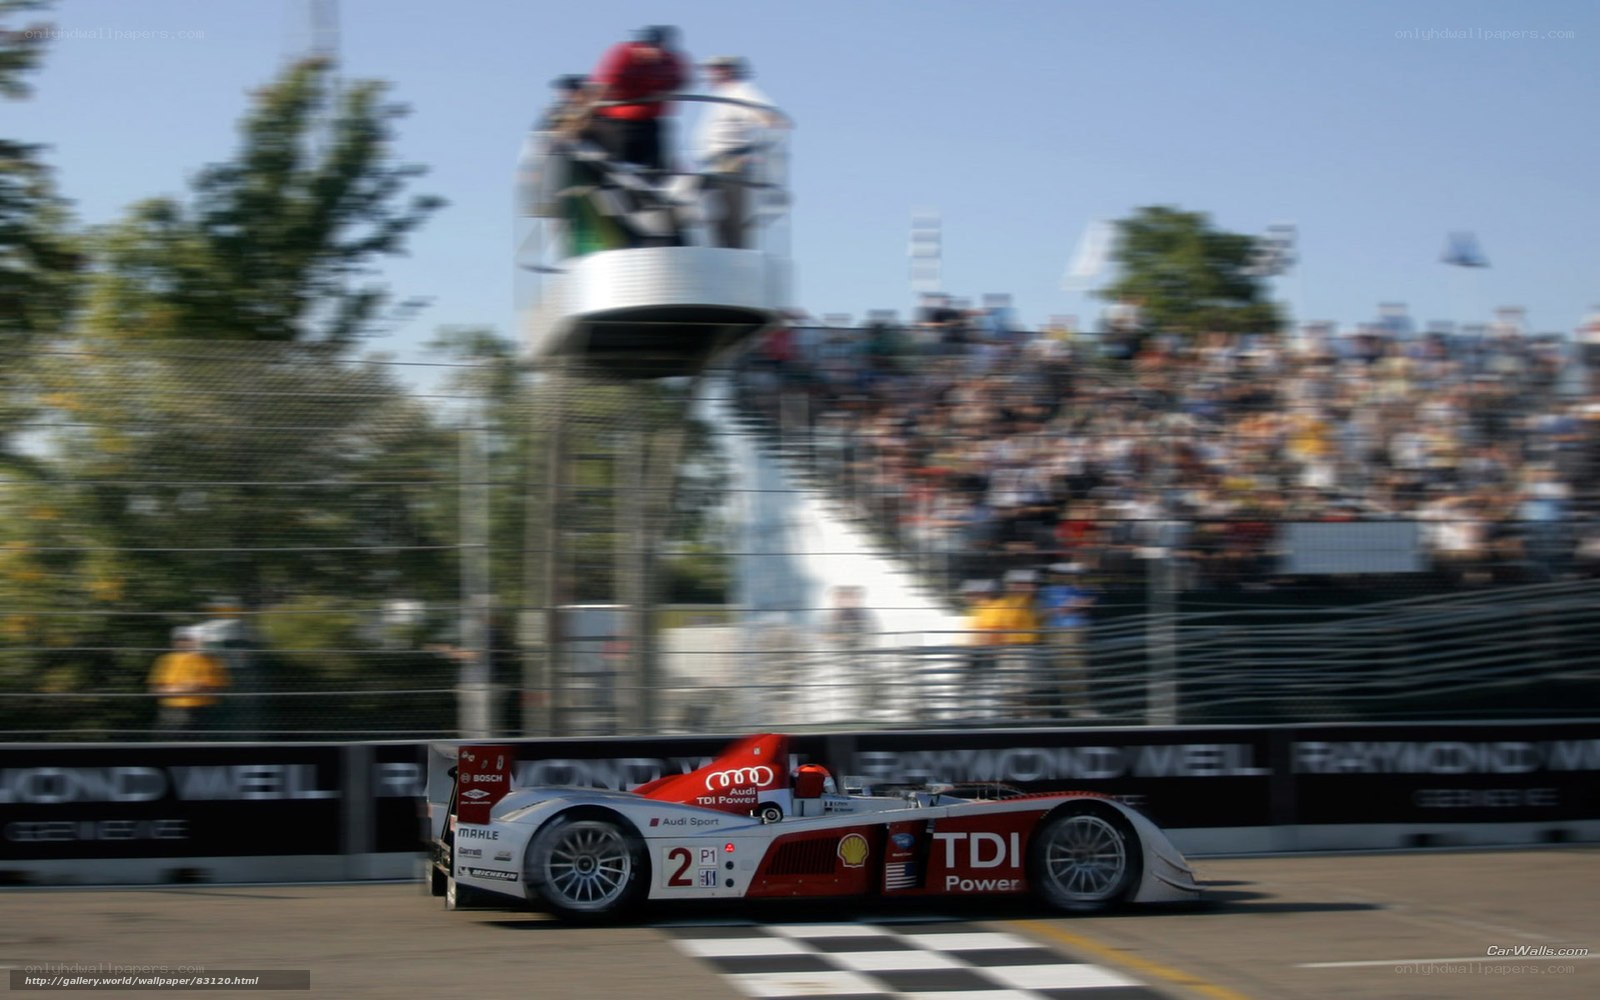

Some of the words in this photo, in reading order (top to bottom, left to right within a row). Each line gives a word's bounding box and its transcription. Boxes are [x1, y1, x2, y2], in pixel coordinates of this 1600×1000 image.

[473, 774, 503, 782] BOSCH
[729, 787, 757, 796] Audi
[696, 797, 716, 805] TDI
[718, 796, 757, 805] Power
[662, 817, 687, 826] Audi
[689, 817, 720, 827] Sport
[458, 828, 499, 841] MAHLE
[701, 849, 717, 863] P1
[933, 832, 1020, 868] TDI
[667, 847, 693, 887] 2
[471, 869, 518, 880] MICHELIN
[946, 875, 1020, 892] Power
